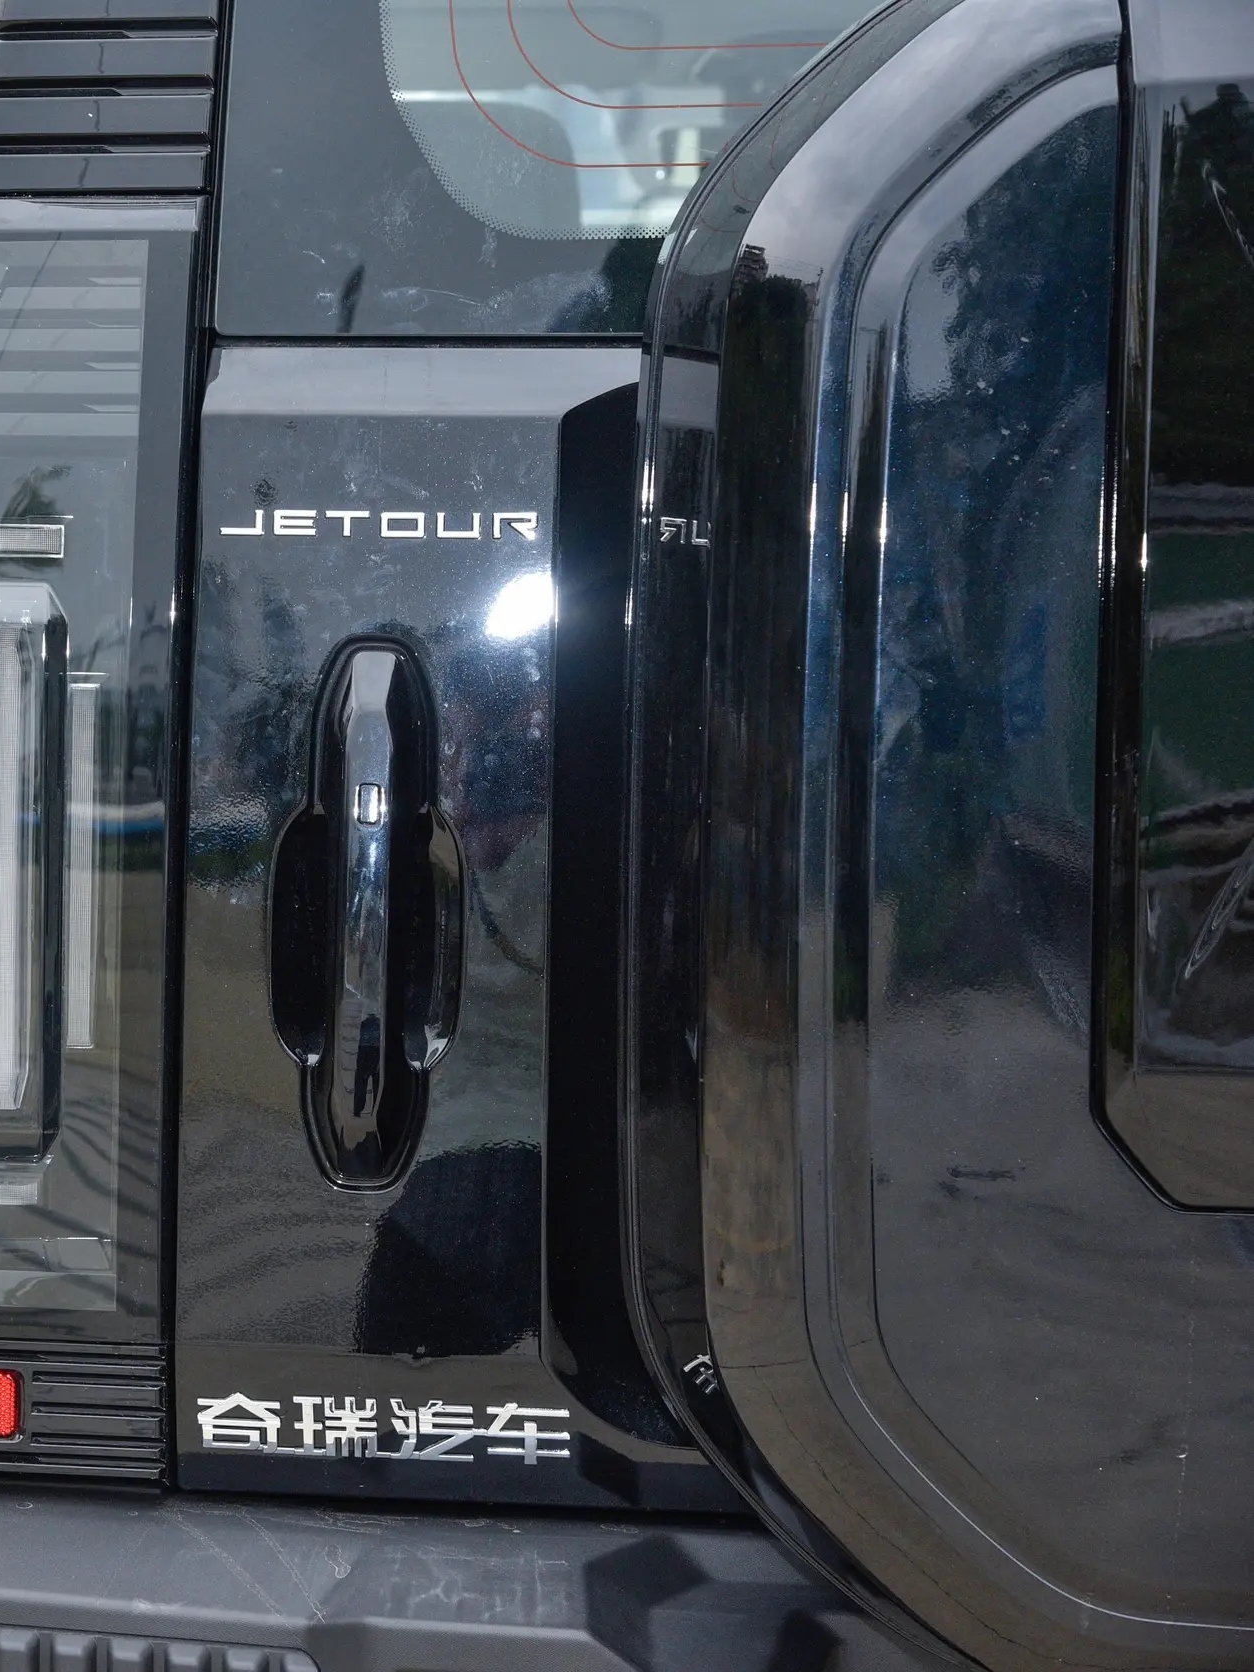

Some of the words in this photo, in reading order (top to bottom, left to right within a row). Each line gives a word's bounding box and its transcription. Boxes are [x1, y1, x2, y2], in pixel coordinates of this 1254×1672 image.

[219, 509, 538, 540] JETOUR
[197, 1392, 570, 1465] 奇瑞汽车
